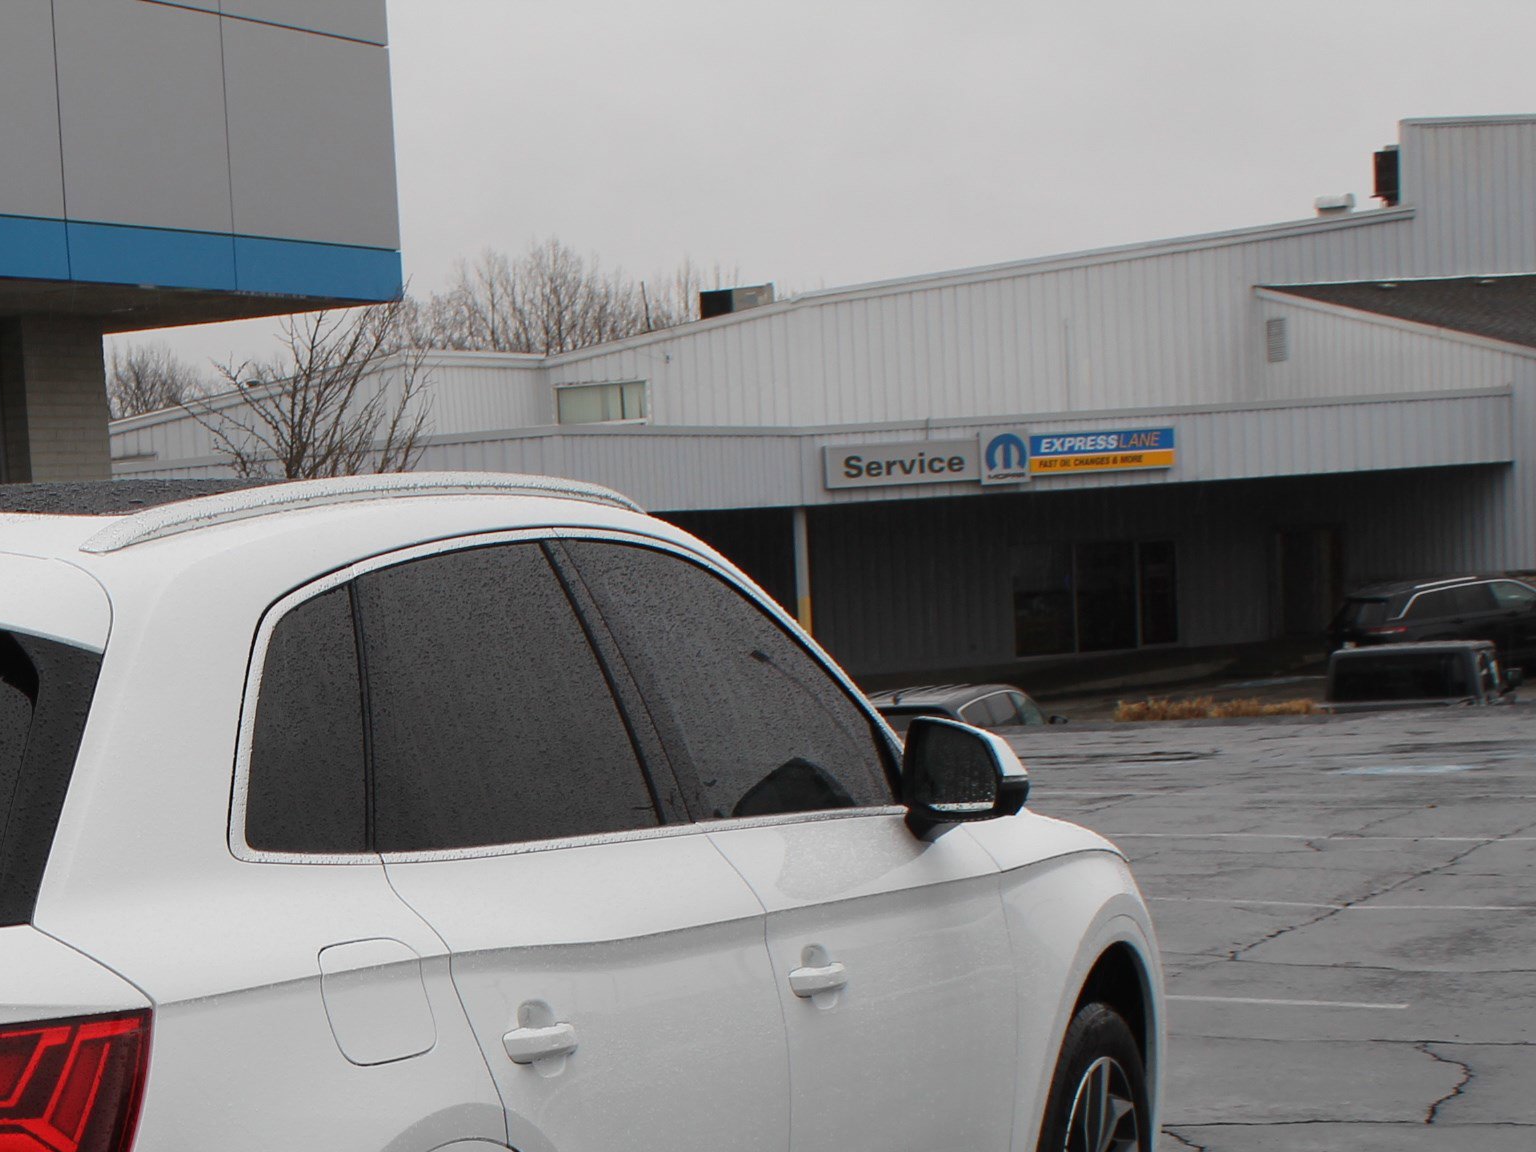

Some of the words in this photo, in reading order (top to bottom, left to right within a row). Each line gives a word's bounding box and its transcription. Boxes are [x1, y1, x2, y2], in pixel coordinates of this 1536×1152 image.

[843, 452, 965, 479] Service
[1038, 459, 1057, 469] FAST
[1073, 455, 1110, 467] CHANGES
[1119, 454, 1143, 465] MORE
